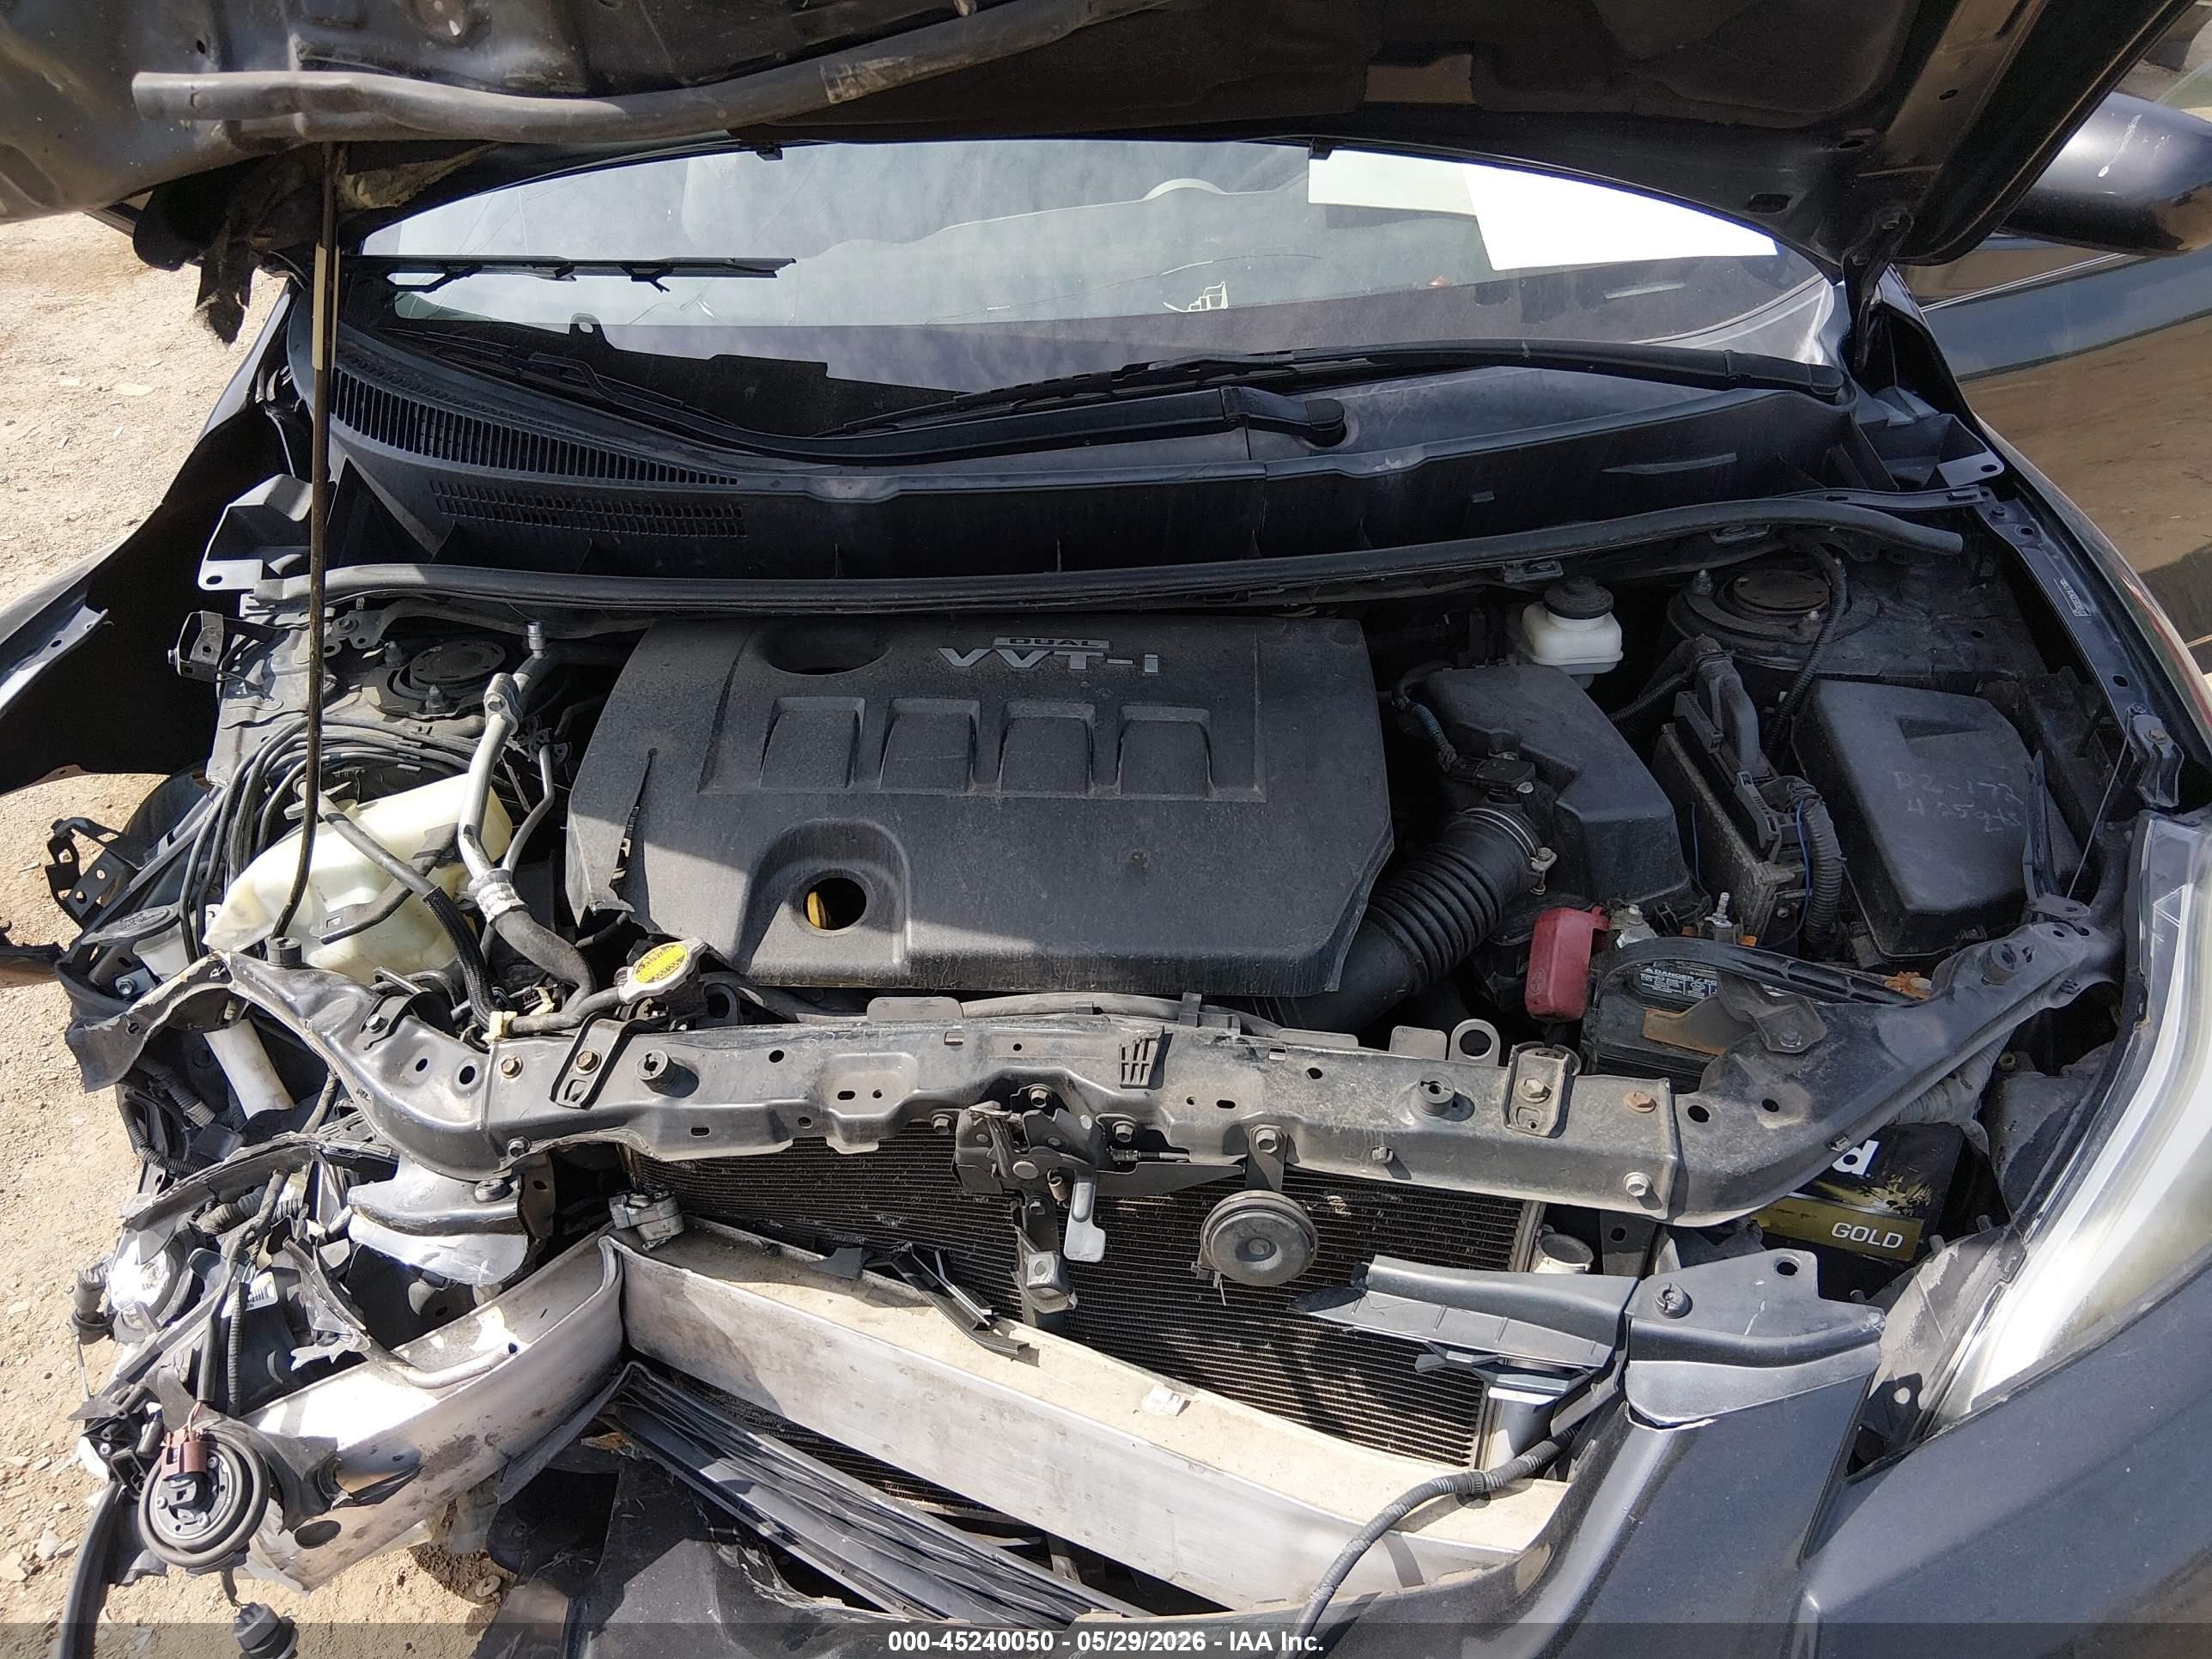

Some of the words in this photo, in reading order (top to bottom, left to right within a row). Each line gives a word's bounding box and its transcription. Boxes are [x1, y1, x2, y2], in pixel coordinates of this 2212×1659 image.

[1009, 638, 1100, 647] DUAL
[937, 647, 1159, 674] VVT-i
[1654, 969, 1694, 981] DANGER
[1832, 1222, 1903, 1249] GOLD
